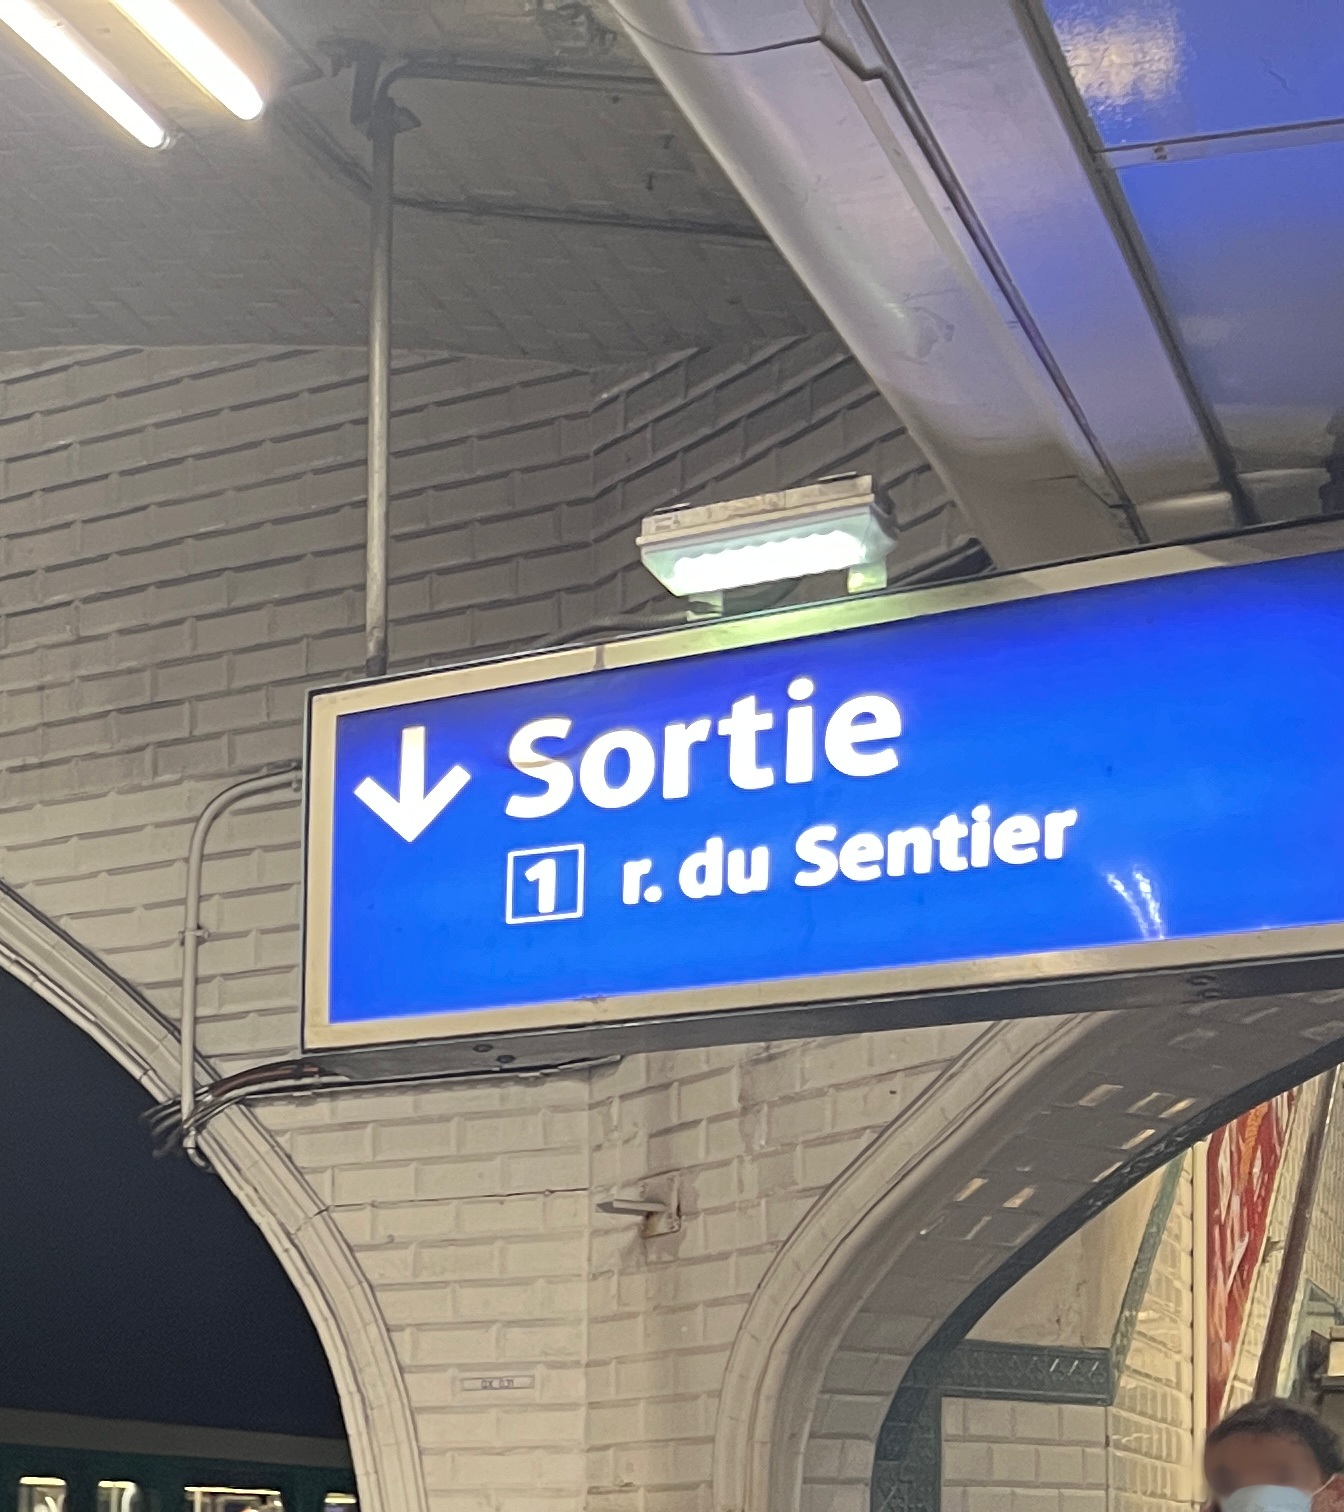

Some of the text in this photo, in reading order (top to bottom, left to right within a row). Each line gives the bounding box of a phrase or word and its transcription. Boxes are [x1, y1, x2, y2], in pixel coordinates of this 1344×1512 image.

[505, 676, 903, 819] Sortie
[622, 858, 663, 905] r.
[678, 836, 770, 899] du
[794, 803, 1079, 888] Sentier
